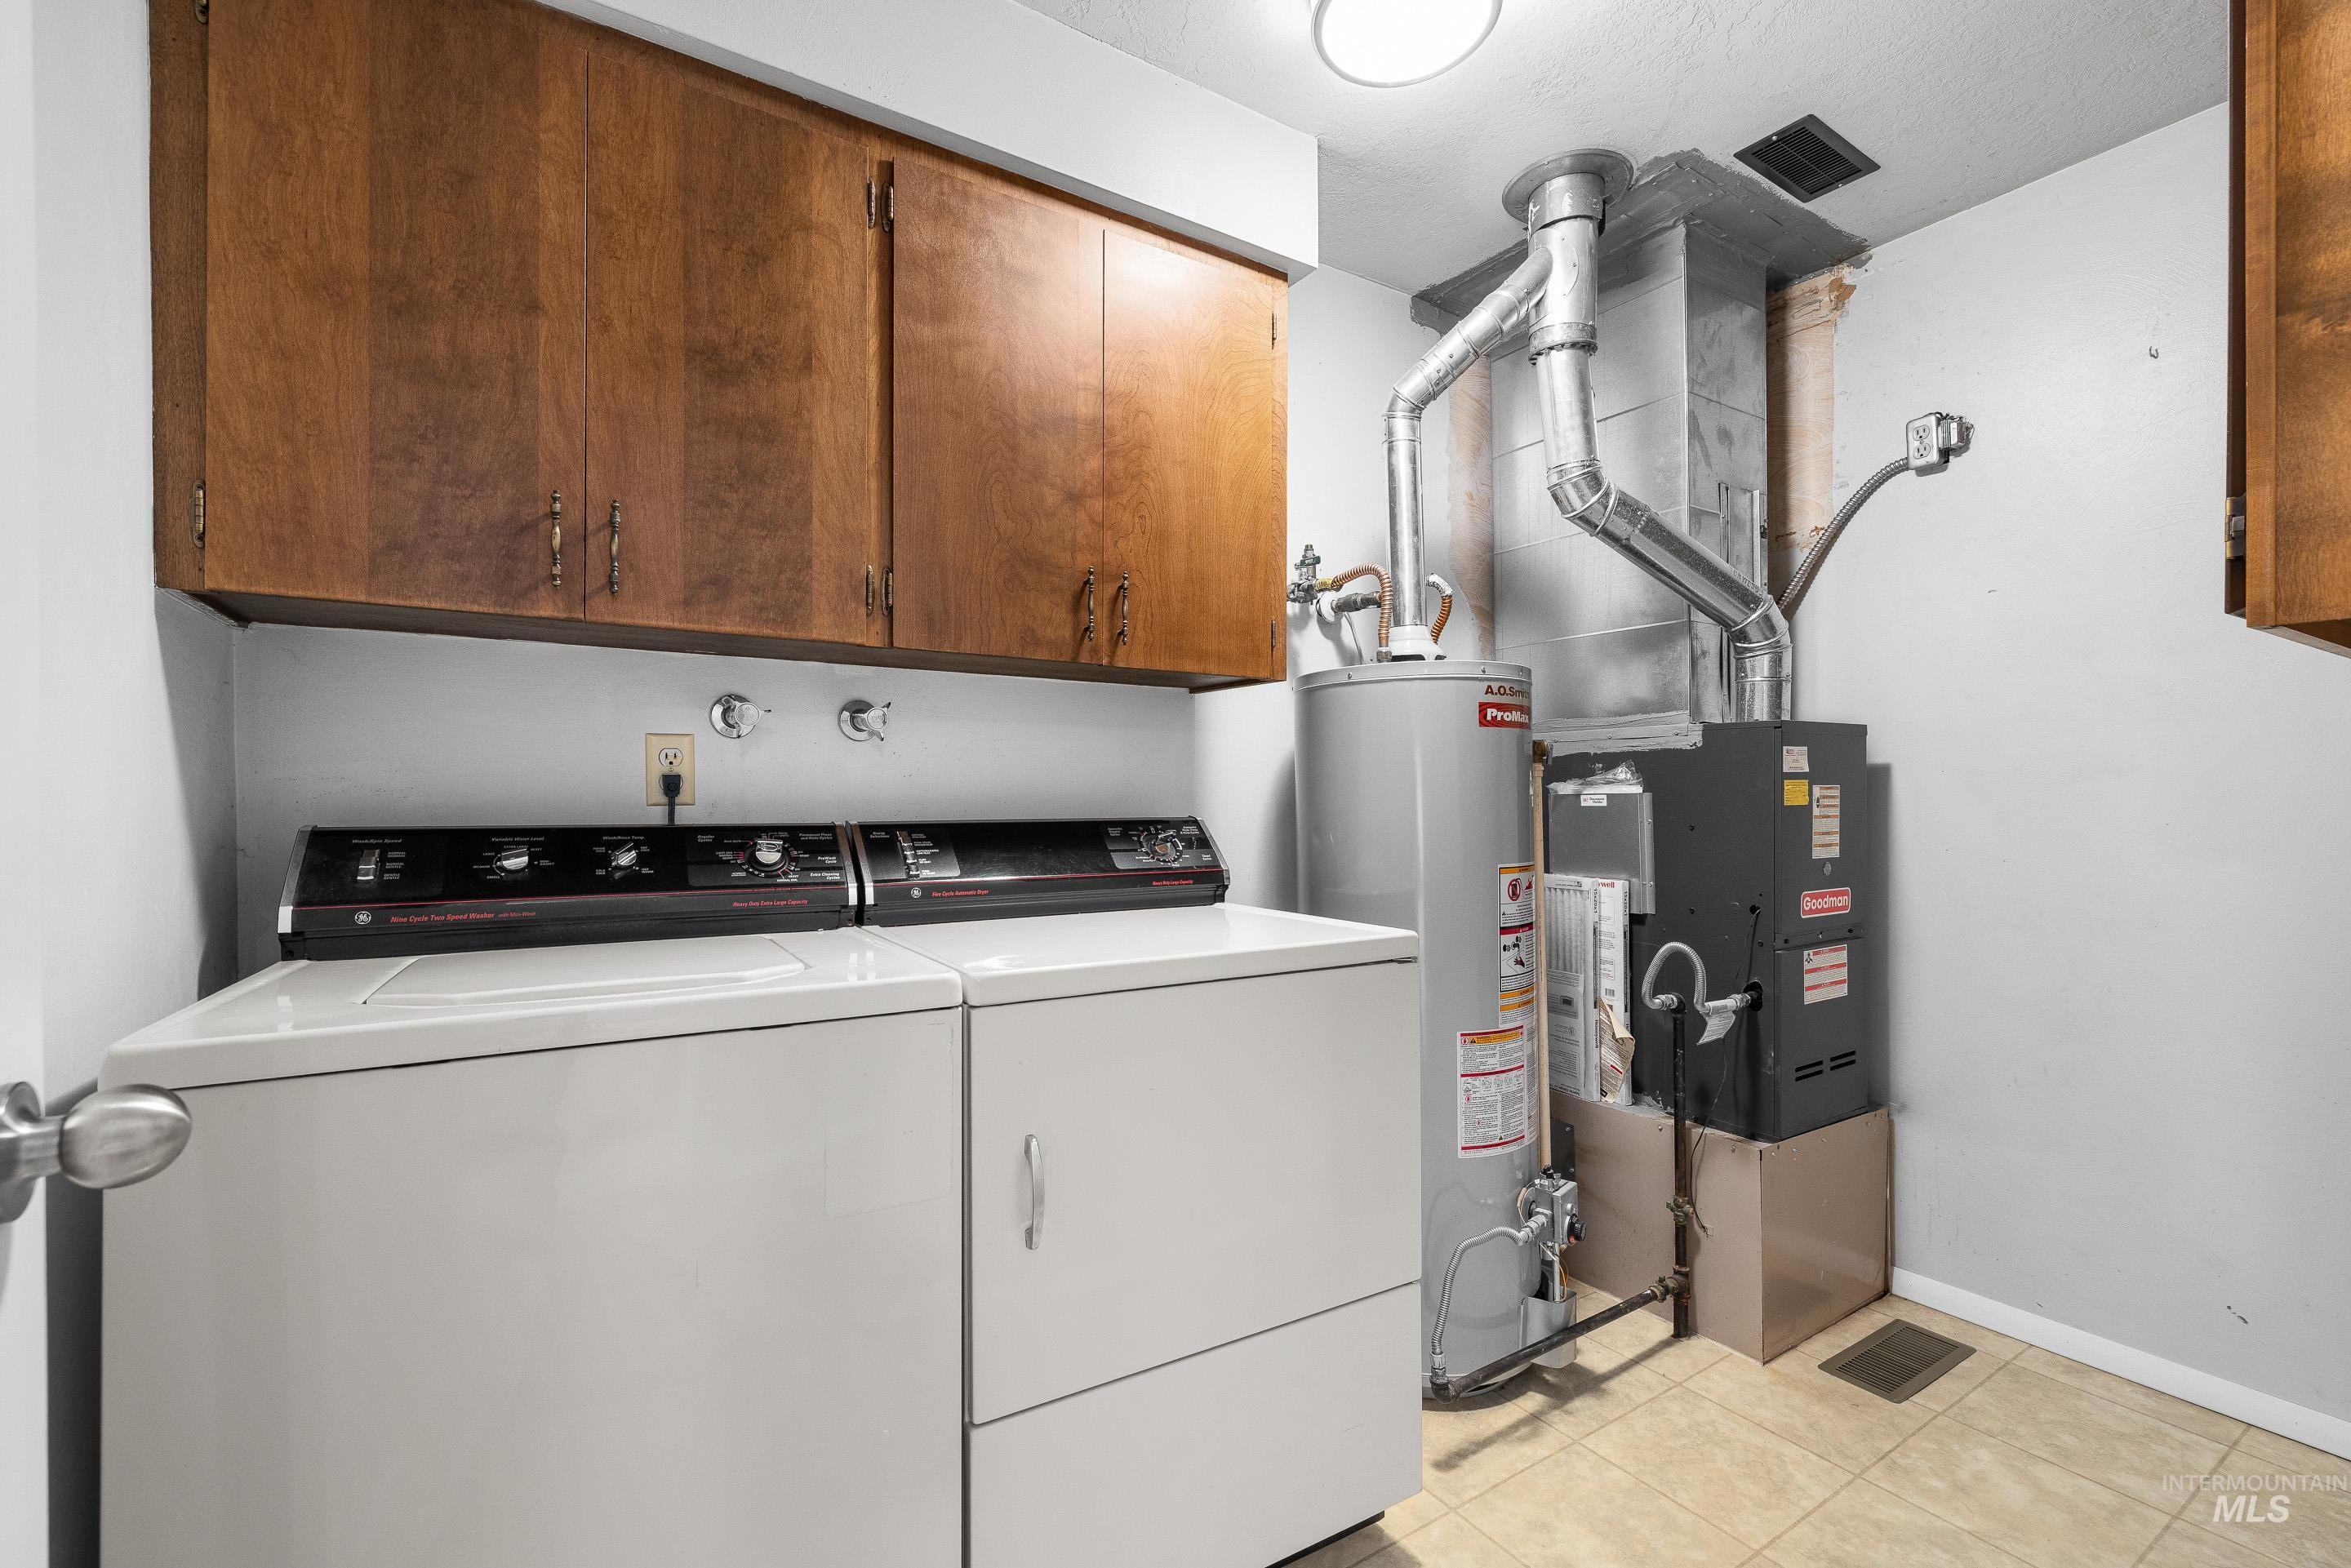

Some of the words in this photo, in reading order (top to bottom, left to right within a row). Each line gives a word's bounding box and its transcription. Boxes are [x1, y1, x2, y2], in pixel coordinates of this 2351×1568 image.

[1484, 684, 1530, 700] A.O.Smith
[1486, 708, 1530, 723] ProMax
[1803, 895, 1849, 911] Goodman
[408, 915, 429, 923] Cycle
[446, 913, 468, 922] Speed
[469, 912, 495, 920] Washer
